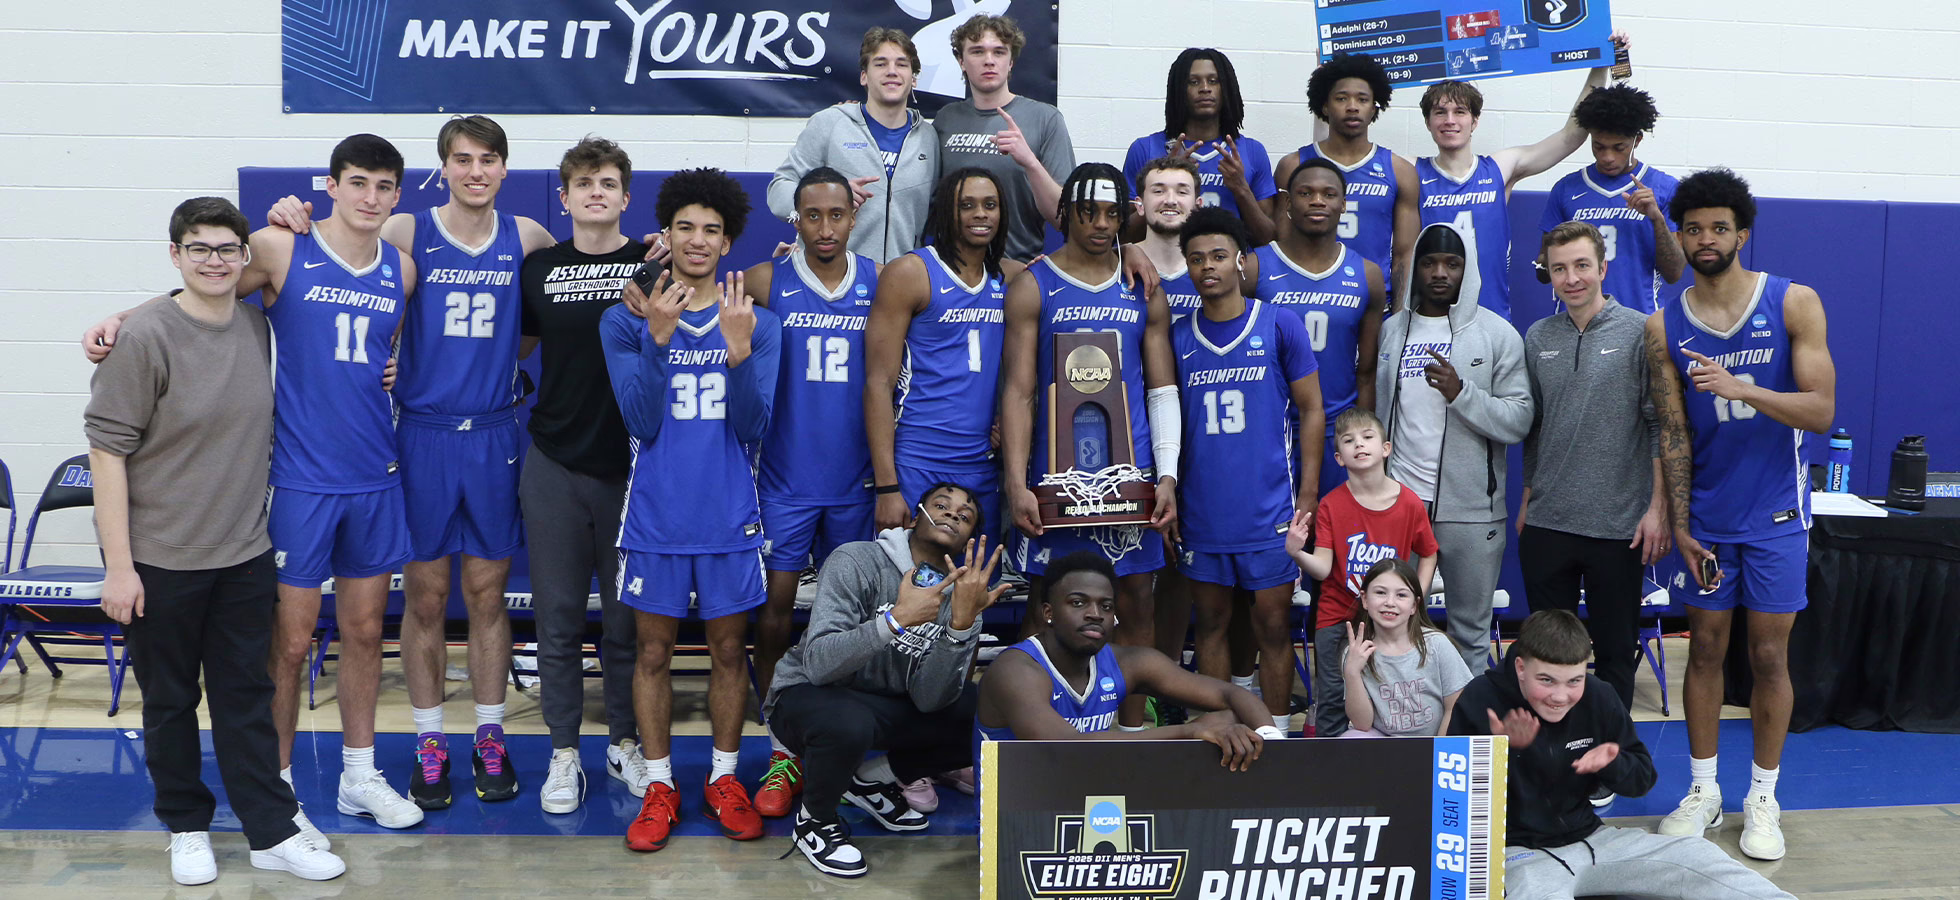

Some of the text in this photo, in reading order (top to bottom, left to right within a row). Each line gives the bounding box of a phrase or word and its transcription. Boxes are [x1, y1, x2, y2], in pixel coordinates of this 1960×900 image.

[1332, 19, 1388, 34] Adelphi (26-7)
[400, 0, 830, 85] MAKE IT YOURS
[1333, 34, 1406, 51] Dominican (20-8)
[1393, 53, 1418, 63] (21-8)
[1564, 51, 1588, 60] HOST
[1387, 69, 1412, 80] (19-9)
[1423, 190, 1497, 208] ASSUMPTION
[1337, 201, 1359, 239] 5
[426, 268, 514, 286] ASSUMPTION
[567, 279, 621, 291] GREYHOUNDS
[304, 285, 397, 314] ASSUMPTION
[552, 290, 623, 303] BASKETBA
[1270, 291, 1361, 309] ASSUMPTION
[443, 291, 496, 338] 22
[938, 307, 1004, 323] ASSUMPTION
[1052, 306, 1140, 324] ASSUMPTION
[334, 312, 370, 364] 11
[1304, 310, 1329, 352] 0
[806, 335, 850, 382] 12
[967, 329, 981, 373] 1
[1070, 367, 1112, 382] NCAA
[1187, 366, 1267, 387] ASSUMPTION
[671, 372, 726, 420] 32
[1203, 389, 1246, 435] 13
[1347, 533, 1396, 563] Team
[1379, 677, 1425, 700] GAME
[1383, 706, 1433, 730] VIBES
[1437, 751, 1467, 792] 25
[1092, 817, 1121, 826] NCAA
[1442, 797, 1459, 828] SEAT
[1231, 816, 1391, 865] TICKET
[1436, 832, 1465, 873] 29
[1068, 855, 1093, 863] 2025
[1094, 855, 1110, 863] DII
[1040, 863, 1172, 888] ELITE EIGHT
[1198, 866, 1416, 900] PUNCHED
